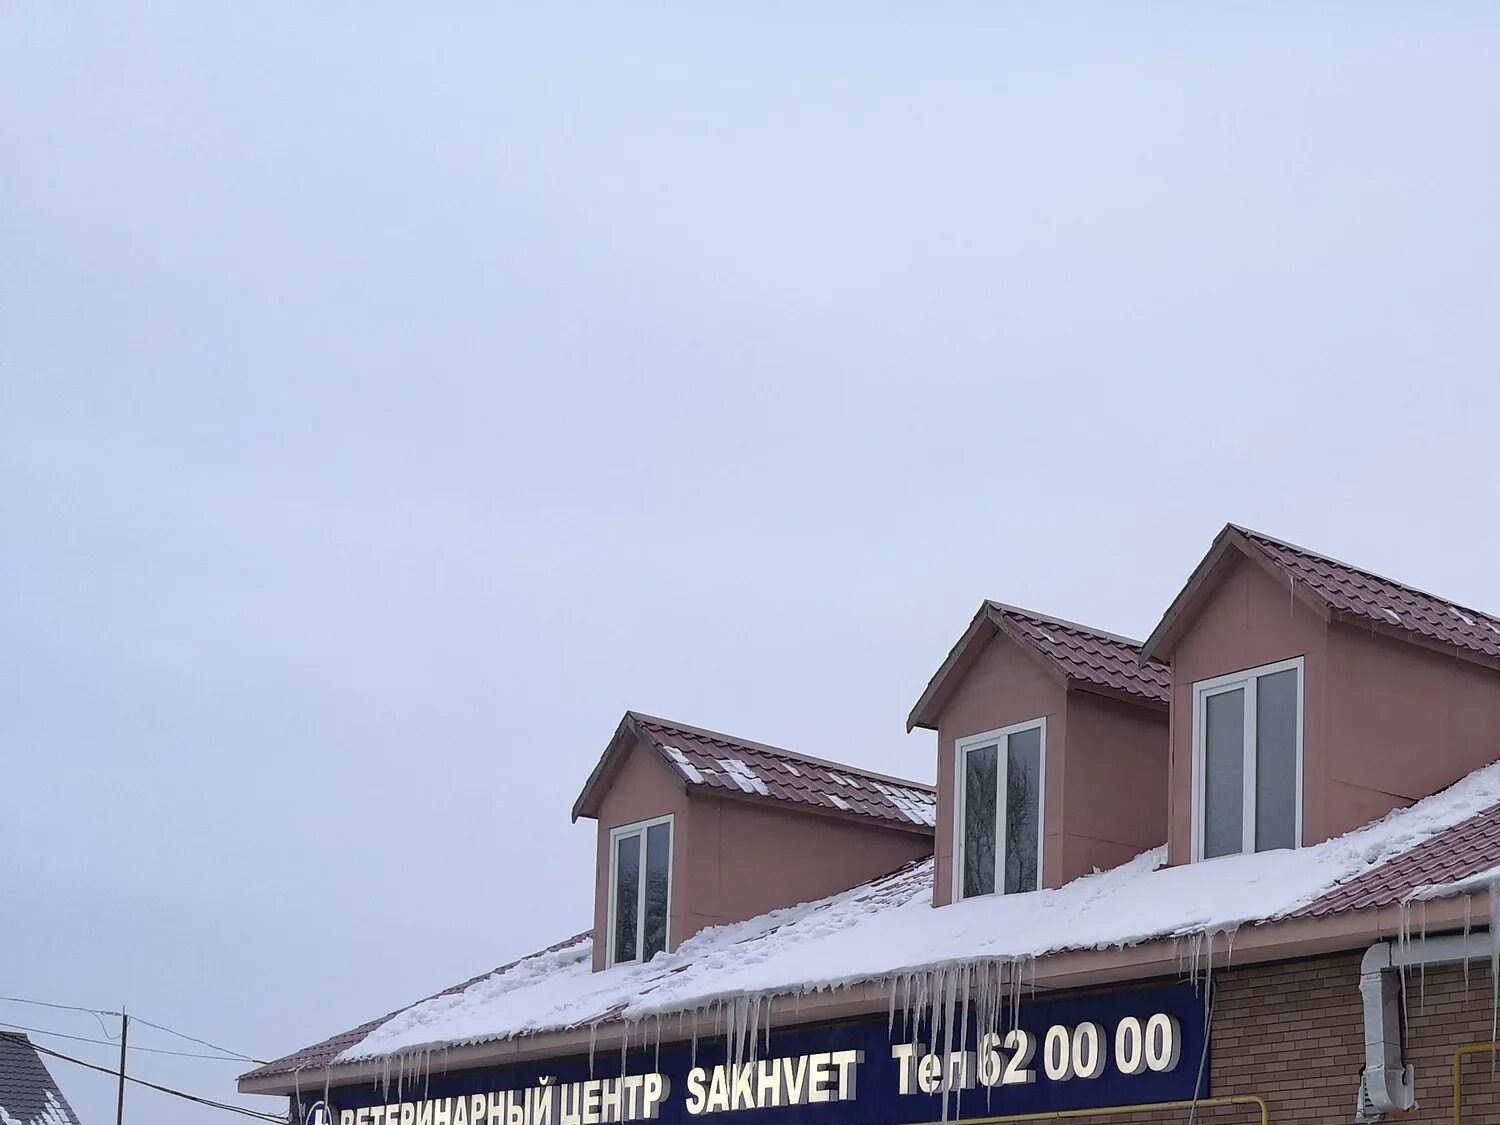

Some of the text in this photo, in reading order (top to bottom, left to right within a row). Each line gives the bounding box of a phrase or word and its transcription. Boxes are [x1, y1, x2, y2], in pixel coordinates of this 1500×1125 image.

[685, 1050, 857, 1115] SAKHVET
[979, 1029, 1029, 1087] 62
[1044, 1022, 1099, 1081] 00
[1115, 1013, 1172, 1074] 00
